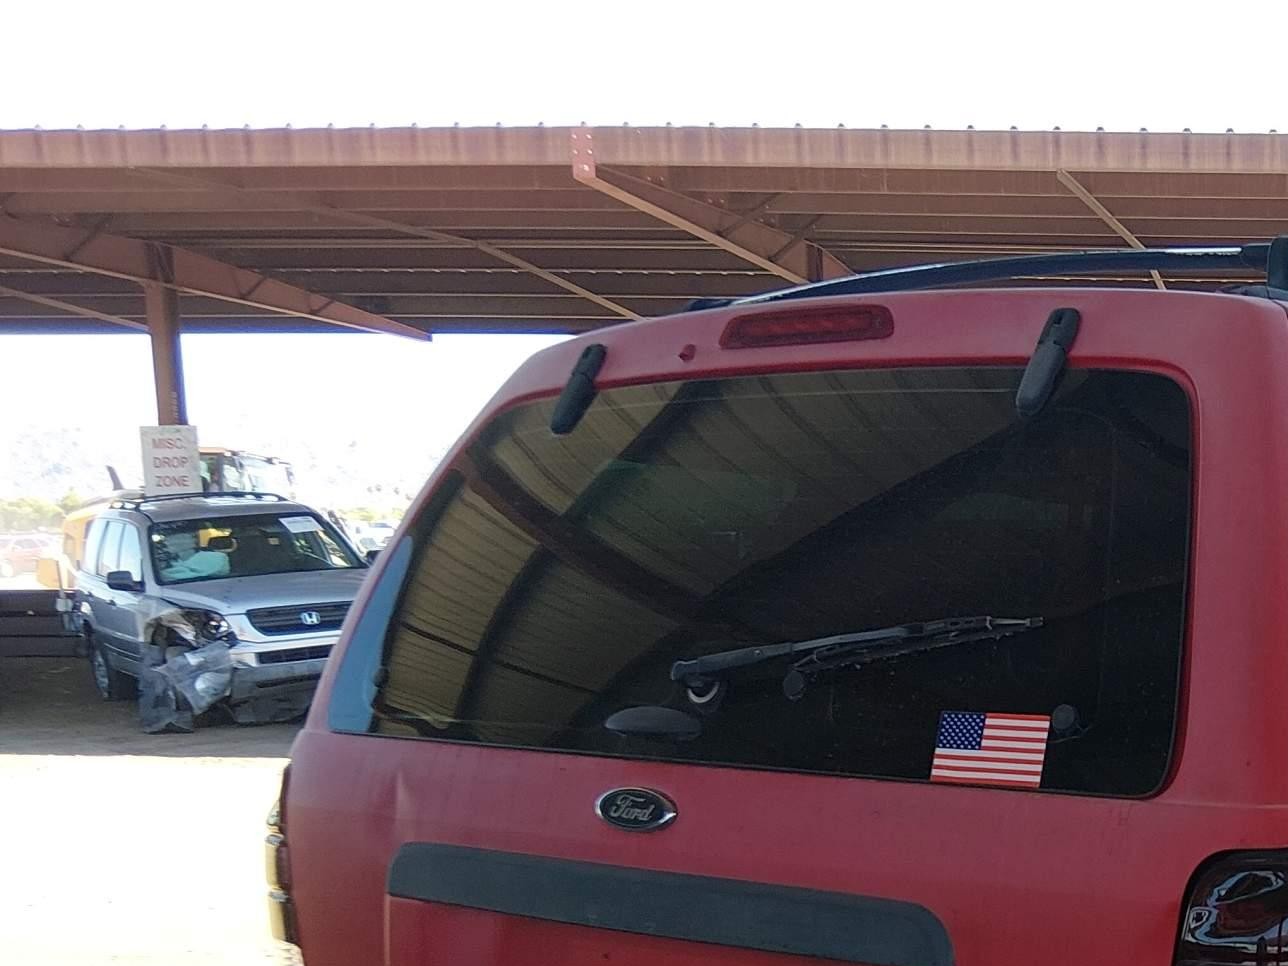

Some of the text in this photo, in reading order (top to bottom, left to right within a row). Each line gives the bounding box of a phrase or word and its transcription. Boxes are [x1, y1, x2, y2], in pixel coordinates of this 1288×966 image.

[153, 456, 188, 469] DROP
[155, 475, 190, 487] ZONE
[610, 794, 656, 821] Ford
